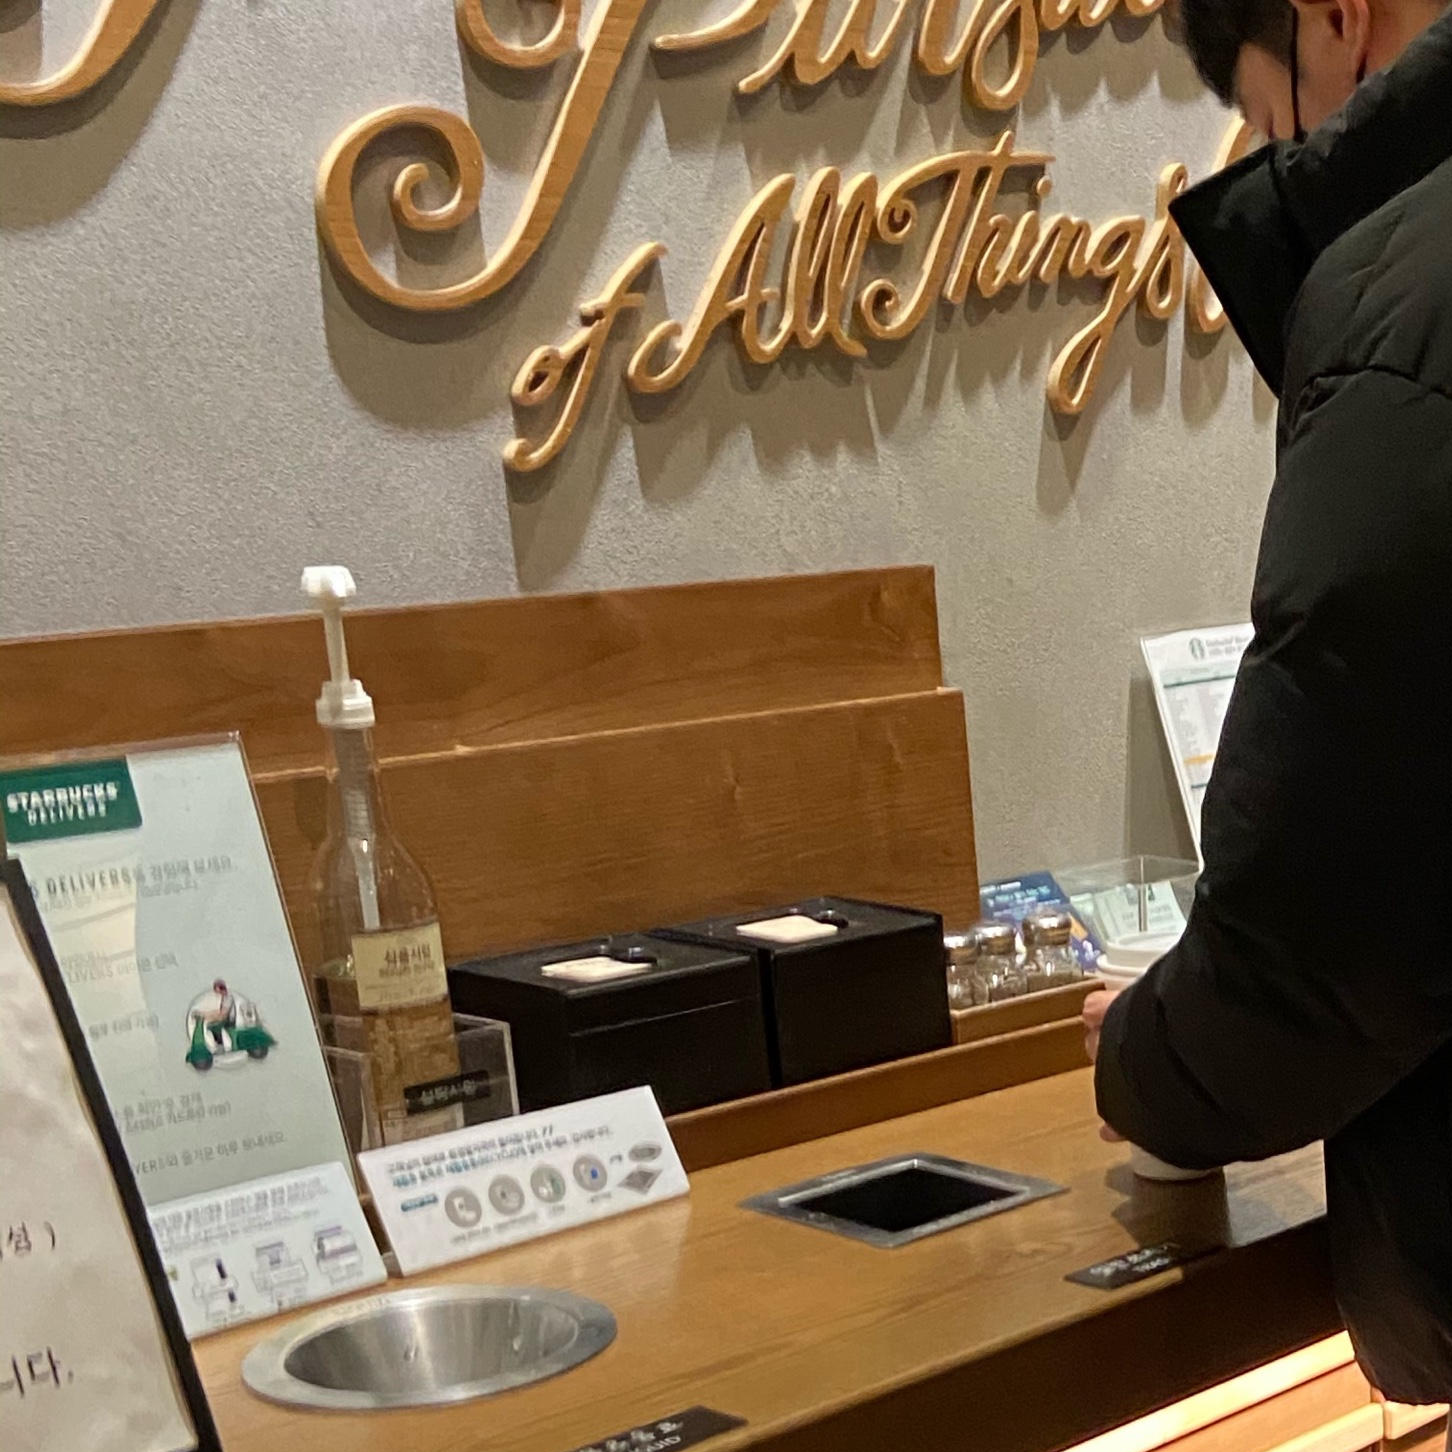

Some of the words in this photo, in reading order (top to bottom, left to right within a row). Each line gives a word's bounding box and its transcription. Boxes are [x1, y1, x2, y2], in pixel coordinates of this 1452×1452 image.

[503, 241, 668, 472] of
[628, 166, 878, 393] All
[860, 130, 1188, 415] Things
[7, 781, 119, 813] STARBUCKS
